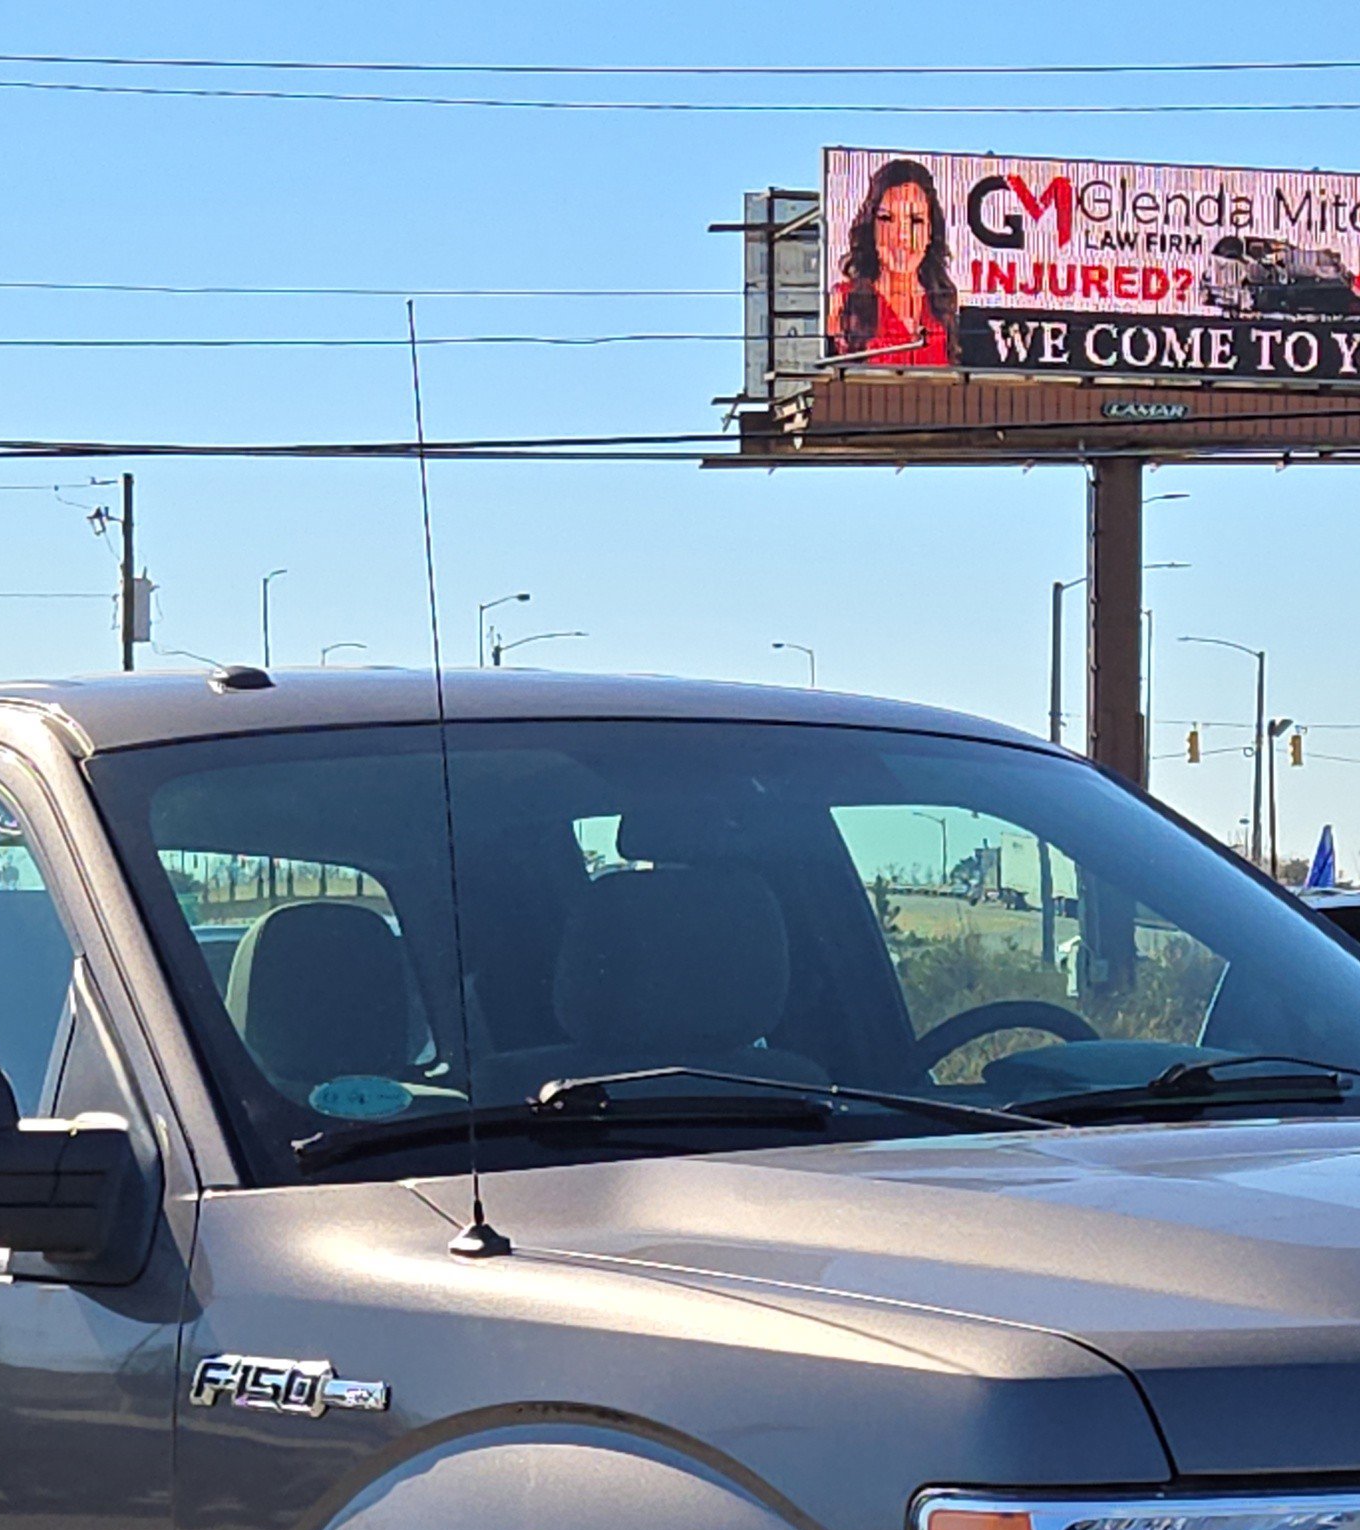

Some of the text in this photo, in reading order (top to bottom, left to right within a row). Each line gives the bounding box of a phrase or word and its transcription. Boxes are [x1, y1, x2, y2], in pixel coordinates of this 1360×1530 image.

[967, 173, 1072, 249] GM
[1079, 177, 1253, 228] Glenda
[1084, 230, 1203, 255] LAW FIRM
[971, 258, 1194, 302] INJURED?
[988, 319, 1070, 364] WE
[1084, 323, 1238, 370] COME
[1250, 327, 1319, 373] TO
[1107, 403, 1185, 417] LAMAR
